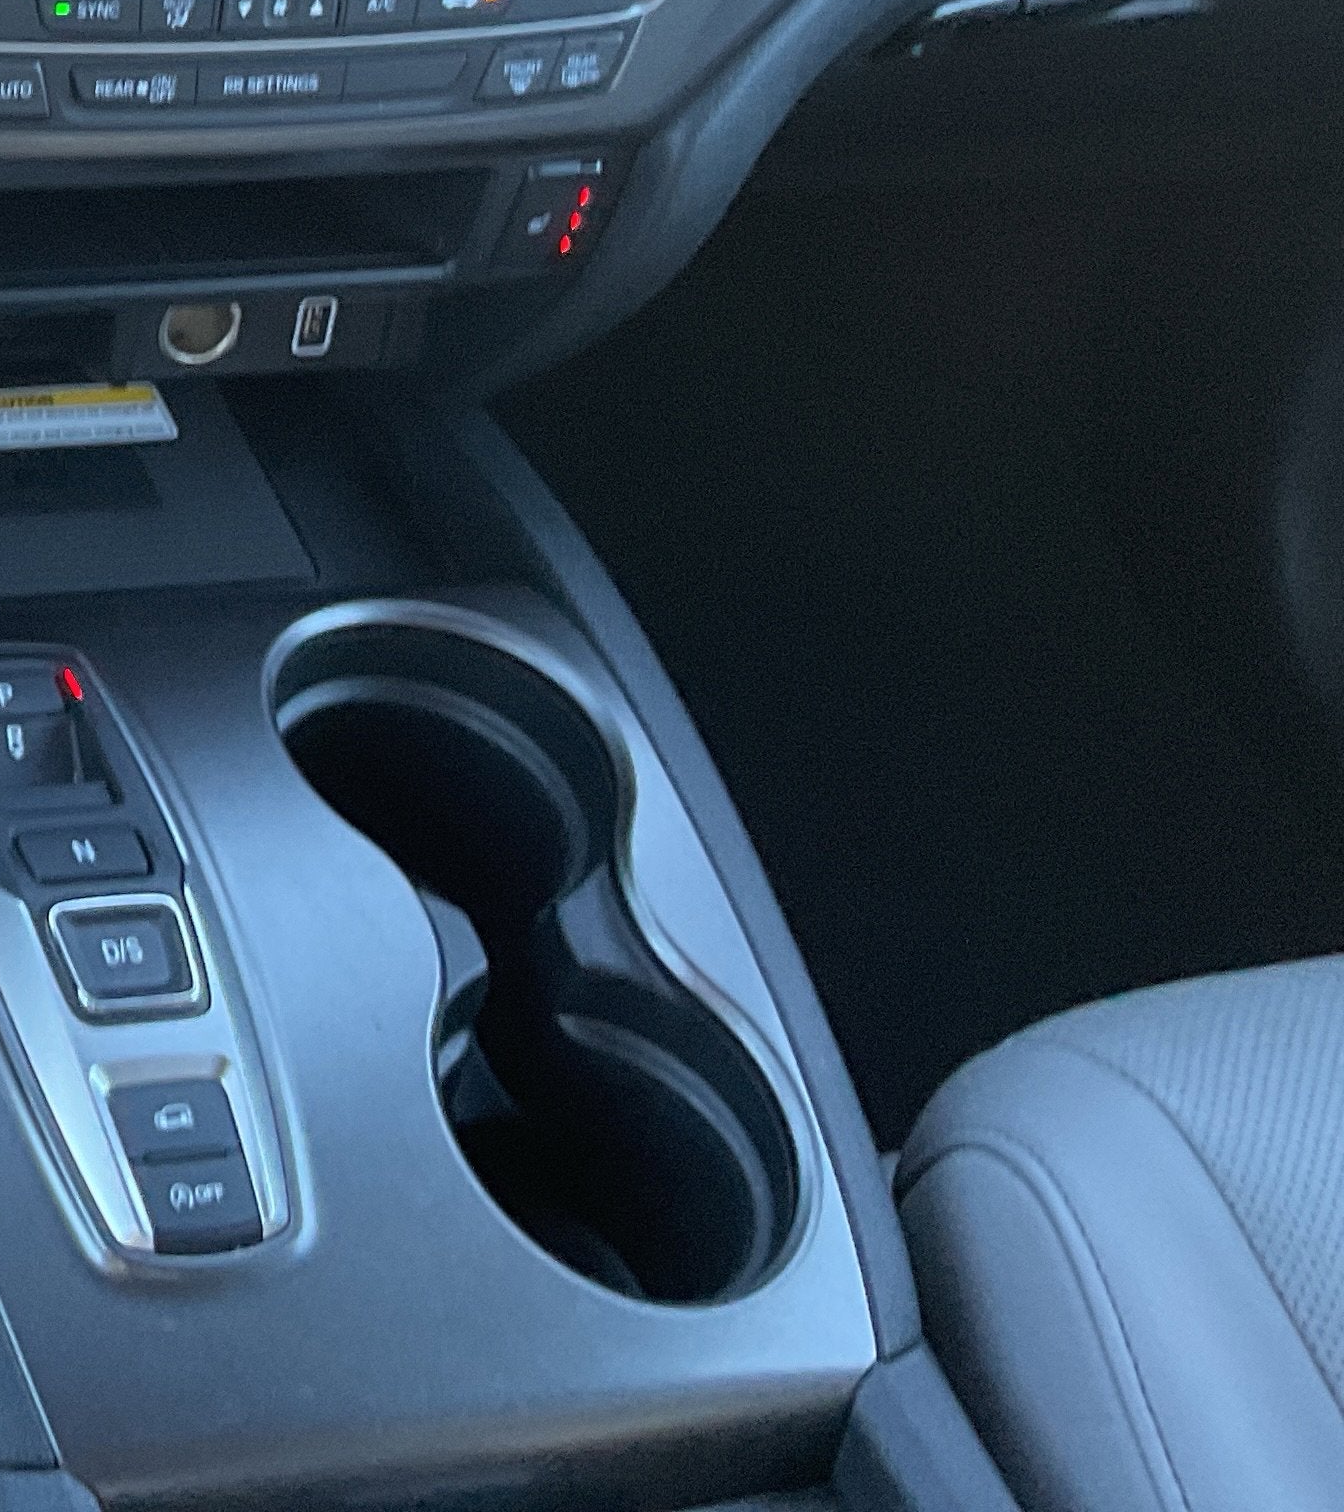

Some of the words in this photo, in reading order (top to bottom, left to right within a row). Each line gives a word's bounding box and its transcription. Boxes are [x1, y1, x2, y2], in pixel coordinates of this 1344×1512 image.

[77, 0, 120, 20] SYNC
[247, 72, 320, 95] SETTINGS
[71, 838, 96, 864] N
[101, 936, 144, 967] D/S
